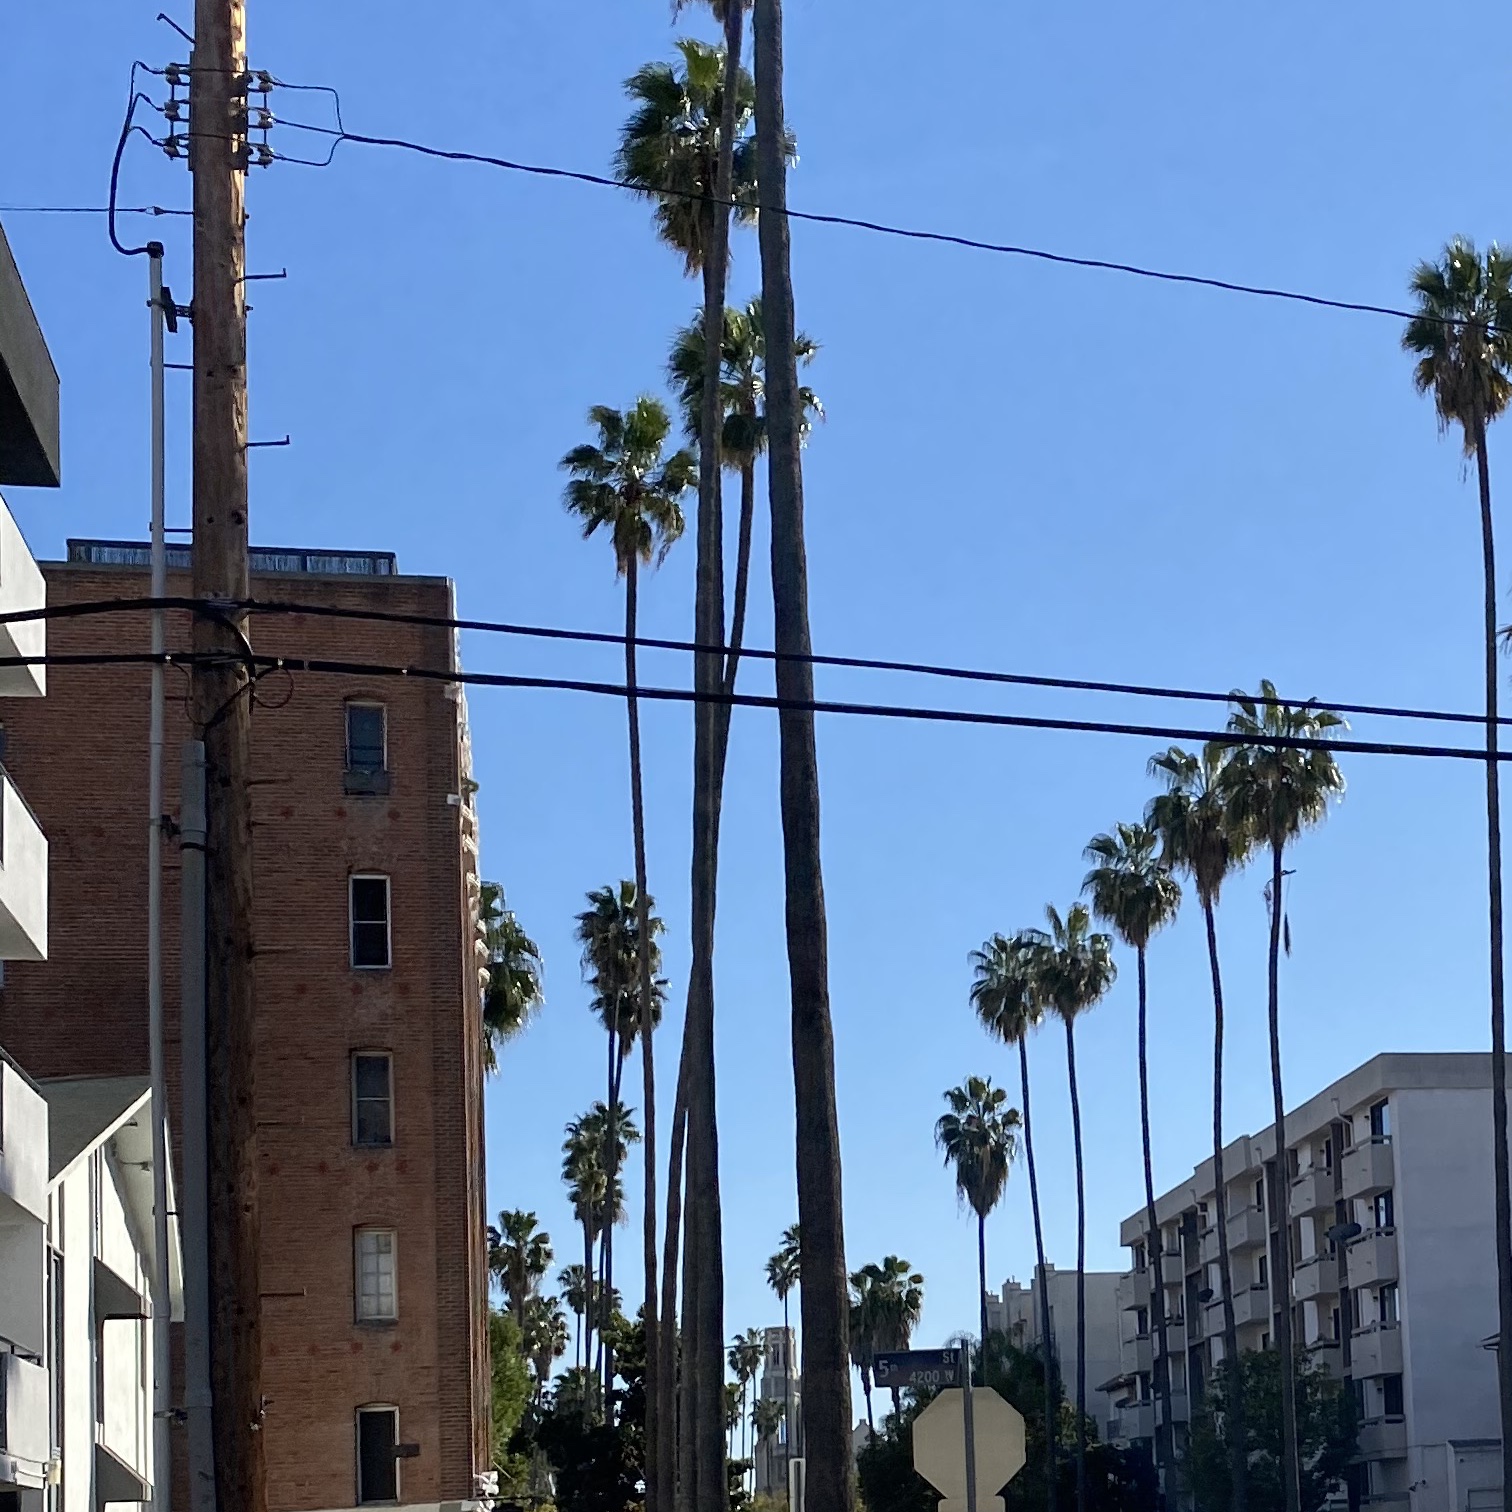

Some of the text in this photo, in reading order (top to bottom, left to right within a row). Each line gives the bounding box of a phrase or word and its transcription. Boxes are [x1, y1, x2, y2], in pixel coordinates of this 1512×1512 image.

[942, 1351, 956, 1364] St
[909, 1369, 955, 1384] 4200 W
